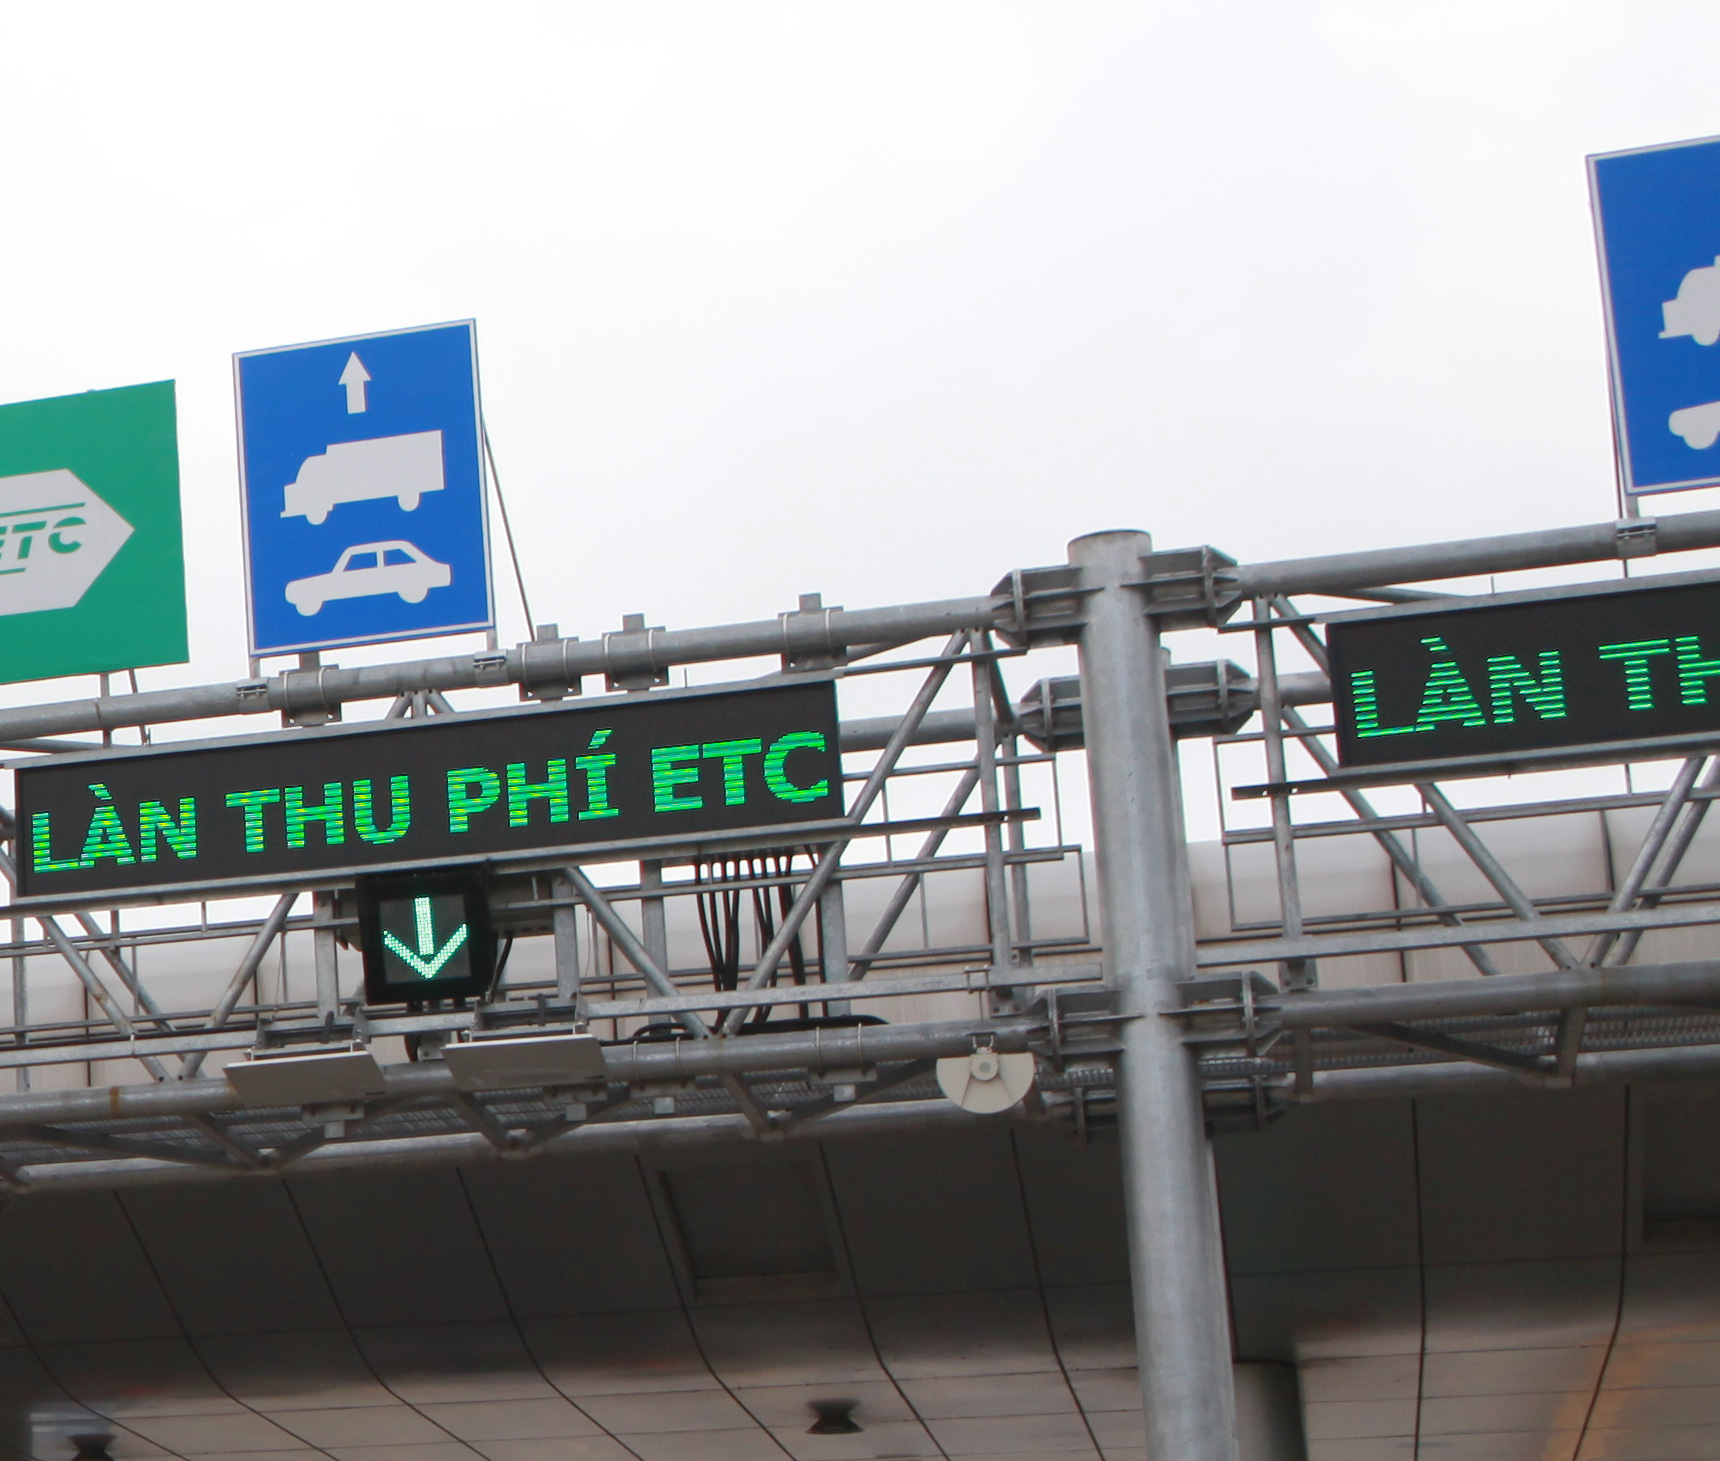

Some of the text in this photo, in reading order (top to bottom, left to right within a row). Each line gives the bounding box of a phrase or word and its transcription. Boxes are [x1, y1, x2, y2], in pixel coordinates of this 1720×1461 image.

[1351, 636, 1567, 738] LÀN
[32, 729, 829, 873] LÀN THU PHÍ ETC
